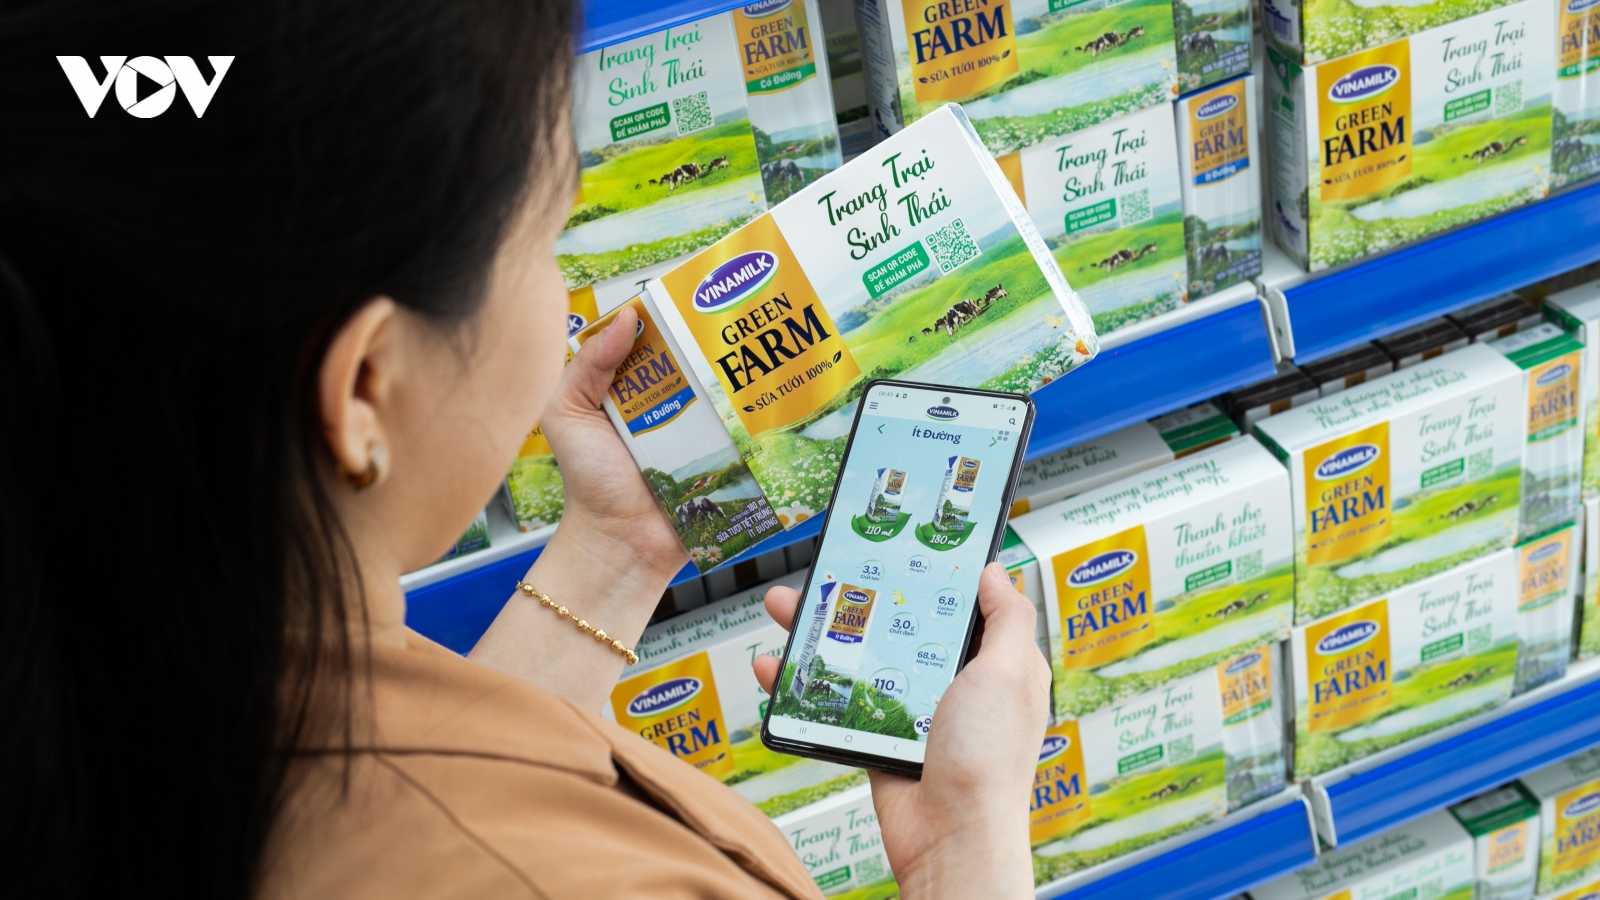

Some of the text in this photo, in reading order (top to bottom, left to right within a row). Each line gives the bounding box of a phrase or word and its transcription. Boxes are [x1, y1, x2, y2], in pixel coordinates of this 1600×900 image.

[751, 16, 793, 39] GREEN
[911, 4, 1008, 65] FARM
[1441, 19, 1526, 62] Trang Trại
[743, 27, 808, 66] FARM
[608, 59, 706, 106] Sinh Thái
[760, 70, 802, 88] Có Đường
[930, 54, 1000, 83] SỮA TƯƠI 100%
[1335, 69, 1394, 96] VINAMILK
[1444, 52, 1523, 93] Sinh Thái
[613, 106, 665, 128] SCAN QR CODE
[1200, 97, 1235, 116] VINAMILK
[1335, 101, 1393, 131] GREEN
[627, 122, 649, 135] KHÁM
[650, 116, 667, 128] PHÁ
[1200, 117, 1235, 138] GREEN
[1055, 128, 1148, 172] Trang Trại
[1193, 126, 1244, 161] FARM
[1323, 114, 1405, 168] FARM
[817, 149, 935, 226] Trang Trại
[1063, 161, 1148, 202] Sinh Thái
[847, 187, 951, 260] Sinh Thái
[698, 254, 772, 304] VINAMILK
[867, 247, 919, 282] SCAN QR CODE
[885, 270, 907, 286] KHÁM
[907, 258, 924, 274] PHÁ
[721, 291, 793, 346] GREEN
[715, 303, 831, 394] FARM
[610, 350, 677, 406] FARM
[755, 359, 833, 410] SỮA TƯƠI 100%
[631, 383, 676, 413] SỮA TƯƠI 100%
[878, 390, 894, 398] 08:43
[1530, 391, 1574, 422] FARM
[643, 399, 682, 425] Ít Đường
[929, 408, 958, 417] VINAMILK
[911, 425, 962, 445] Ít Đường
[1320, 447, 1375, 475] VINAMILK
[956, 474, 976, 483] FARM
[1321, 473, 1374, 503] GREEN
[746, 495, 767, 512] 180 ml
[1311, 483, 1385, 535] FARM
[716, 531, 731, 543] SỮA
[727, 522, 744, 536] TƯƠI
[752, 506, 773, 523] TRÙNG
[755, 516, 778, 534] ĐƯỜNG
[865, 525, 894, 537] 110 ml
[1174, 502, 1261, 547] Thanh nhẹ
[930, 535, 960, 546] 180 ml
[1073, 553, 1131, 582] VINAMILK
[846, 592, 869, 602] VINAMILK
[1078, 579, 1134, 610] GREEN
[666, 613, 718, 636] thương
[833, 611, 867, 628] FARM
[842, 605, 865, 615] GREEN
[1066, 590, 1147, 641] FARM
[637, 638, 682, 662] Thanh
[688, 627, 715, 643] nhẹ
[1321, 624, 1375, 650] VINAMILK
[1324, 649, 1375, 676] GREEN
[633, 681, 696, 711] VINAMILK
[1314, 659, 1386, 704] FARM
[640, 708, 702, 741] GREEN
[790, 826, 842, 850] Trang
